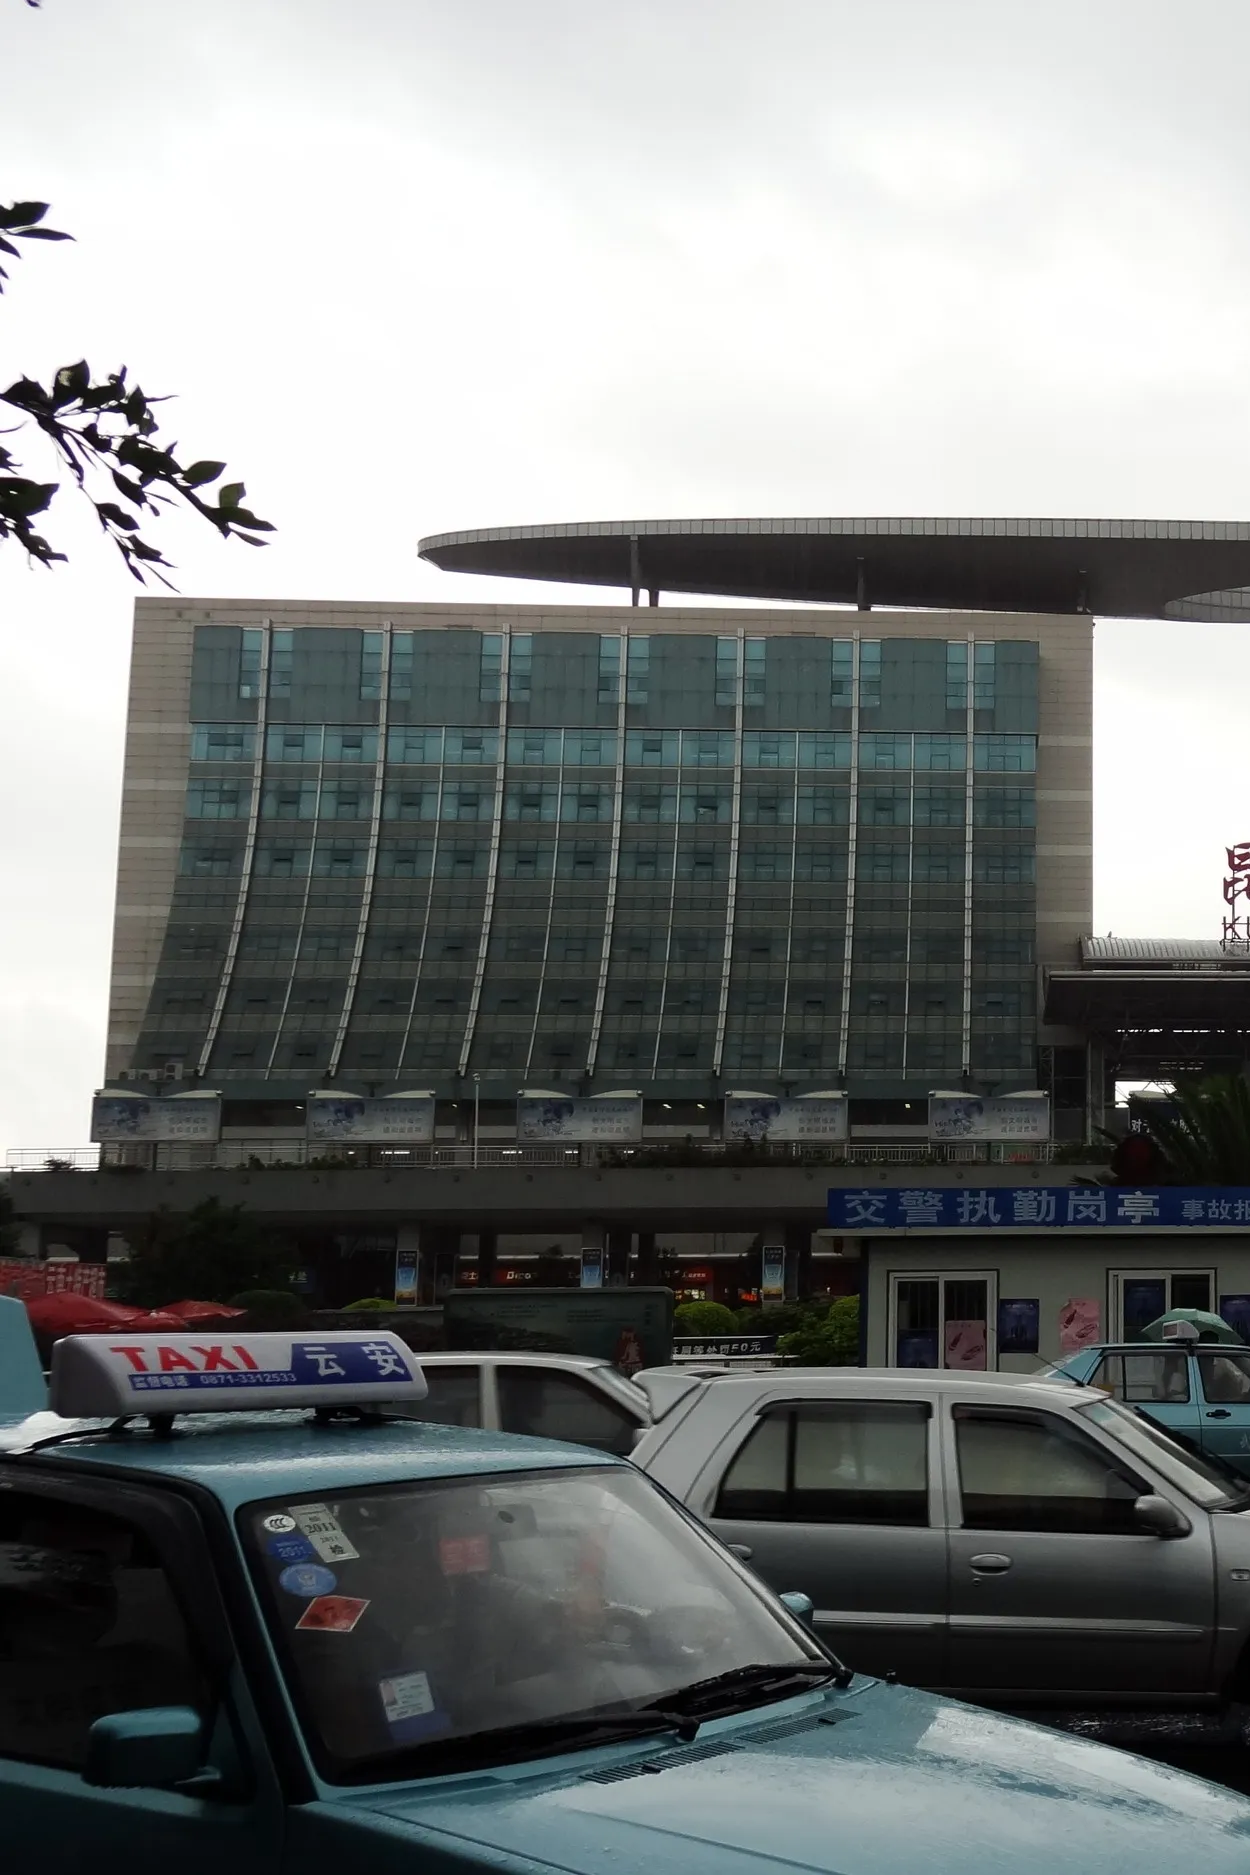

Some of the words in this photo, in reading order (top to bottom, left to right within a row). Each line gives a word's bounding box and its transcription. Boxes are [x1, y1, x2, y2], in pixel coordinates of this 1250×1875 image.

[844, 1190, 1161, 1225] 交警执勤岗亭
[110, 1345, 258, 1372] TAXI
[302, 1342, 405, 1377] 云安
[304, 1522, 337, 1534] 2011
